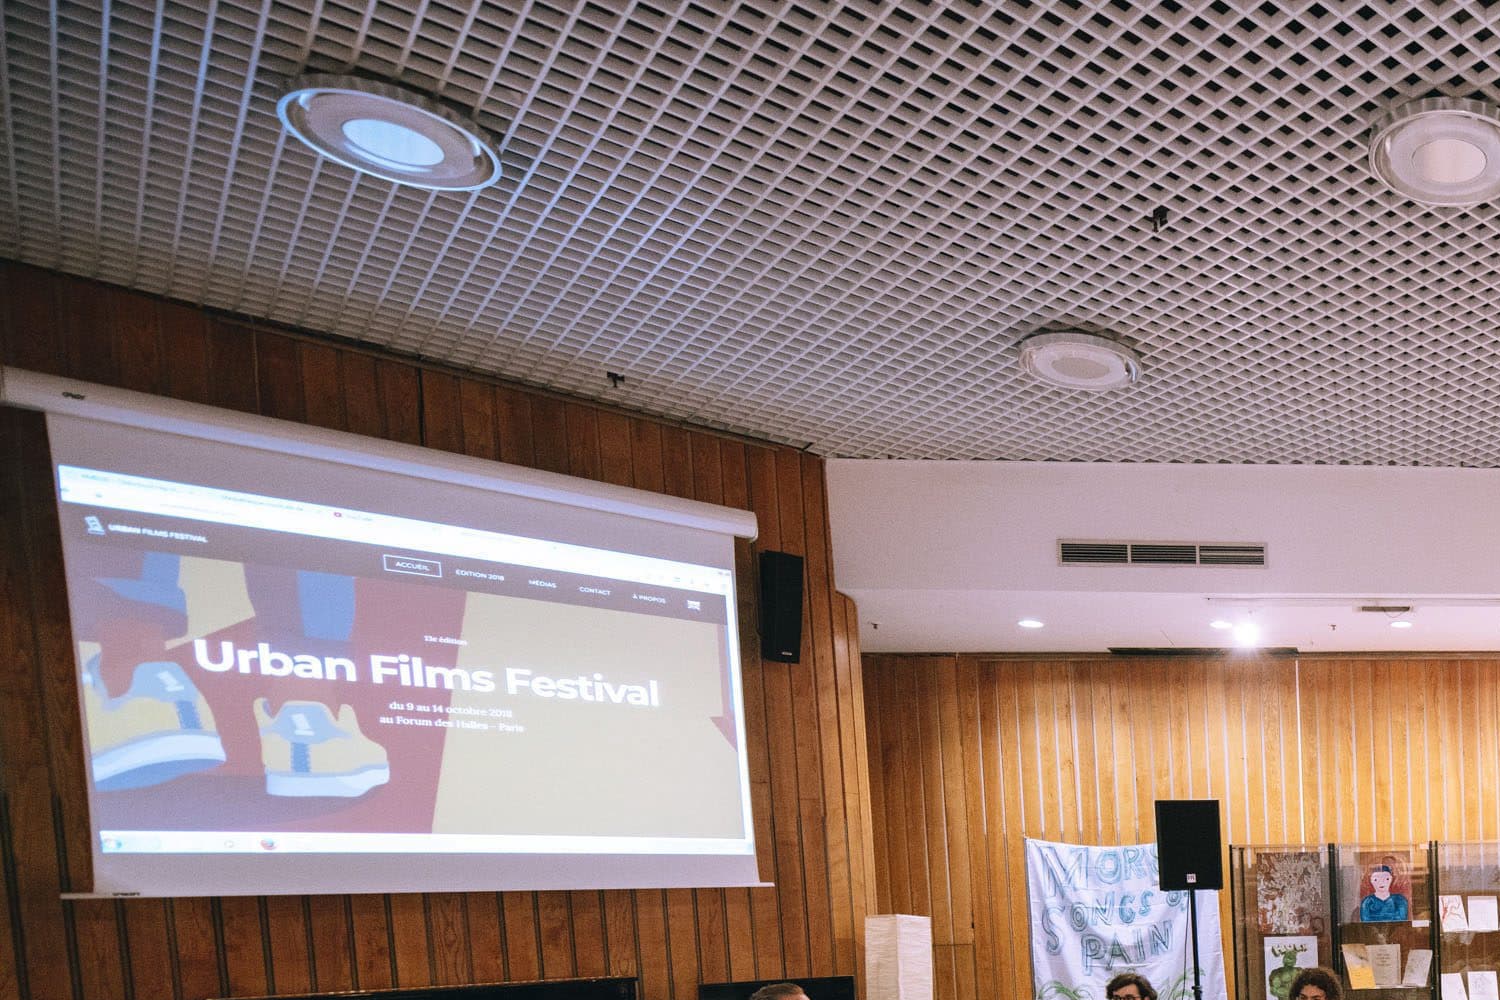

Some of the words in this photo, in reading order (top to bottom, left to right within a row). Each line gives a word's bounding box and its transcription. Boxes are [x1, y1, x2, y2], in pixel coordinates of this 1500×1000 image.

[107, 523, 141, 535] URBAN
[142, 527, 168, 539] FILMS
[169, 531, 208, 543] FESTIVAL
[395, 560, 430, 572] ACCUEIL
[455, 568, 487, 580] EDITION
[488, 572, 505, 582] 2018
[579, 586, 611, 597] CONTACT
[639, 594, 667, 605] PROPOS
[439, 635, 468, 646] édition
[192, 638, 358, 685] Urban
[370, 653, 496, 693] Films
[505, 666, 660, 707] Festival
[389, 701, 405, 711] du
[407, 703, 414, 712] 9
[416, 704, 430, 713] au
[432, 704, 443, 714] 14
[445, 705, 488, 717] octobre
[489, 708, 513, 718] 2018
[380, 716, 393, 725] au
[396, 716, 433, 727] Forum
[435, 718, 453, 728] des
[456, 719, 488, 731] Halles
[499, 723, 525, 733] Paris
[1081, 919, 1173, 977] PAIN
